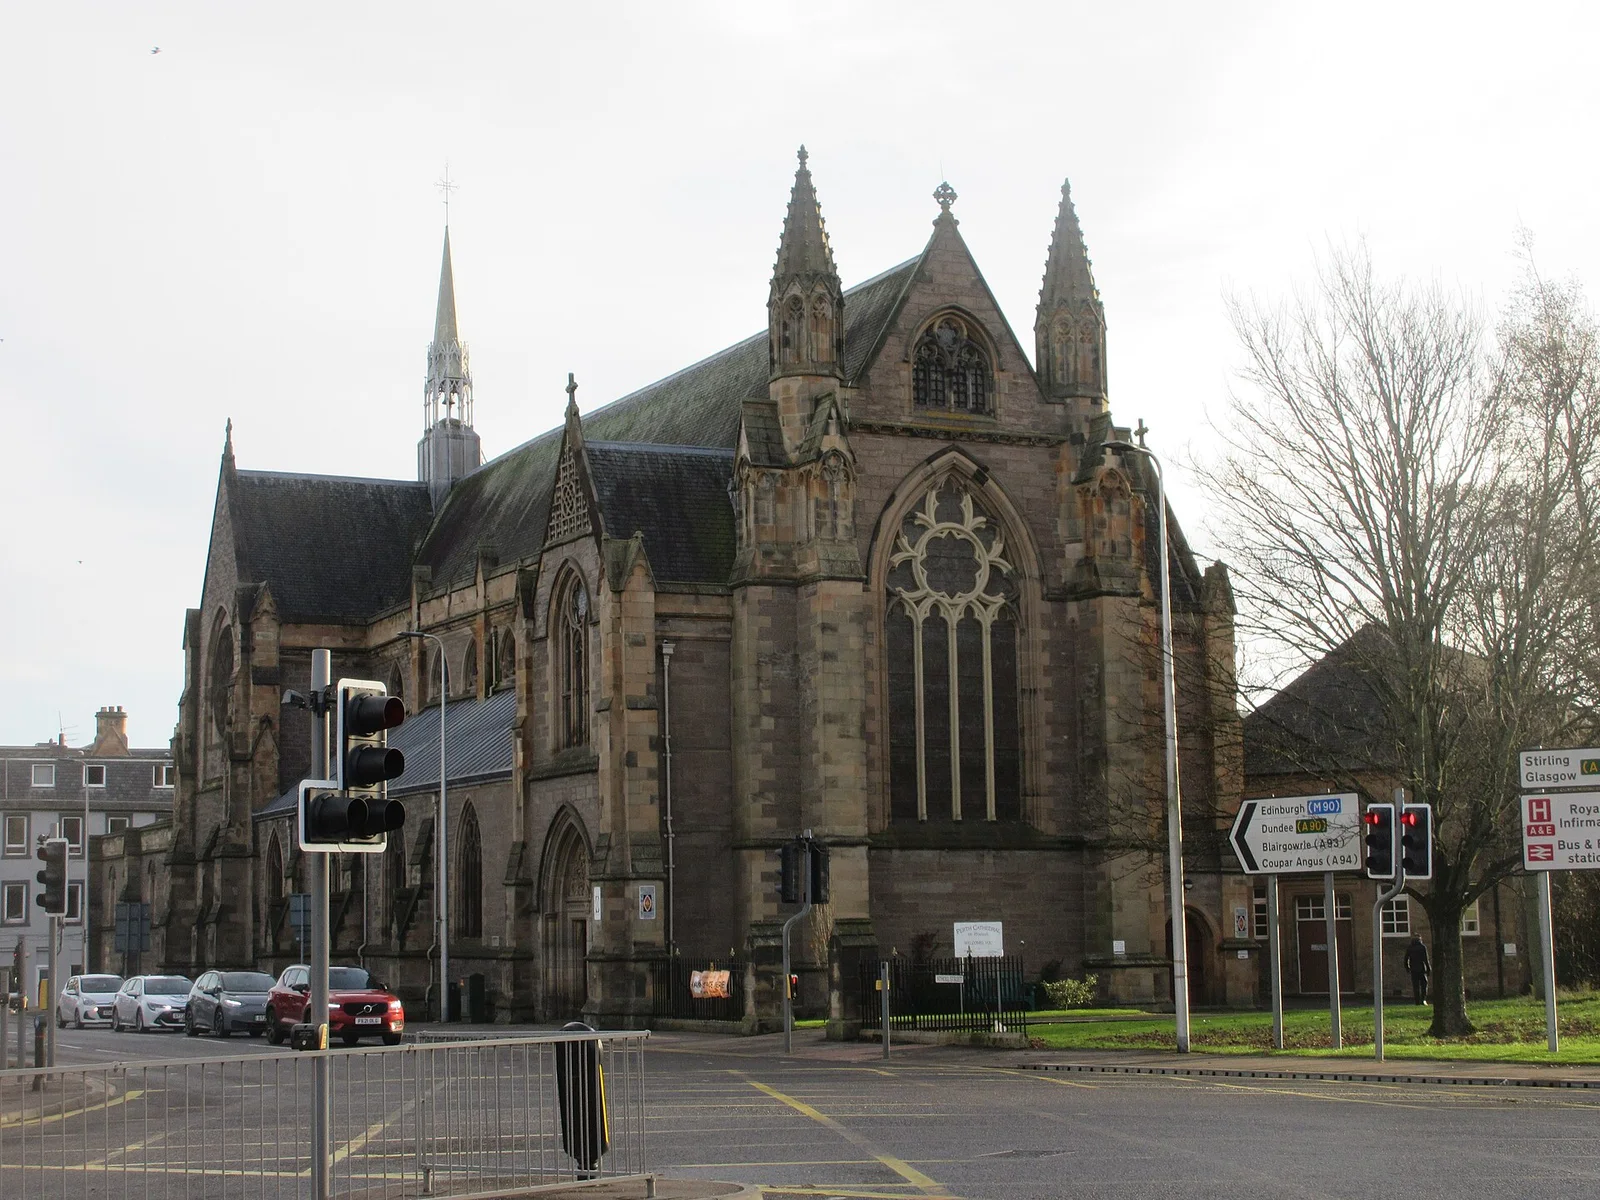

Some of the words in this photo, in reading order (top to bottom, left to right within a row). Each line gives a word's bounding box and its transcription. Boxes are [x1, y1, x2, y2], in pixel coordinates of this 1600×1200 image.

[1525, 755, 1570, 767] Stirling
[1525, 771, 1577, 783] Glasgow
[1261, 804, 1305, 816] Edinburgh
[1261, 823, 1294, 833] Dundee
[1262, 840, 1311, 853] Blairgowrie
[1557, 840, 1580, 851] Bus
[1584, 839, 1592, 850] &
[1262, 858, 1293, 869] Coupar
[1296, 857, 1323, 868] Angus
